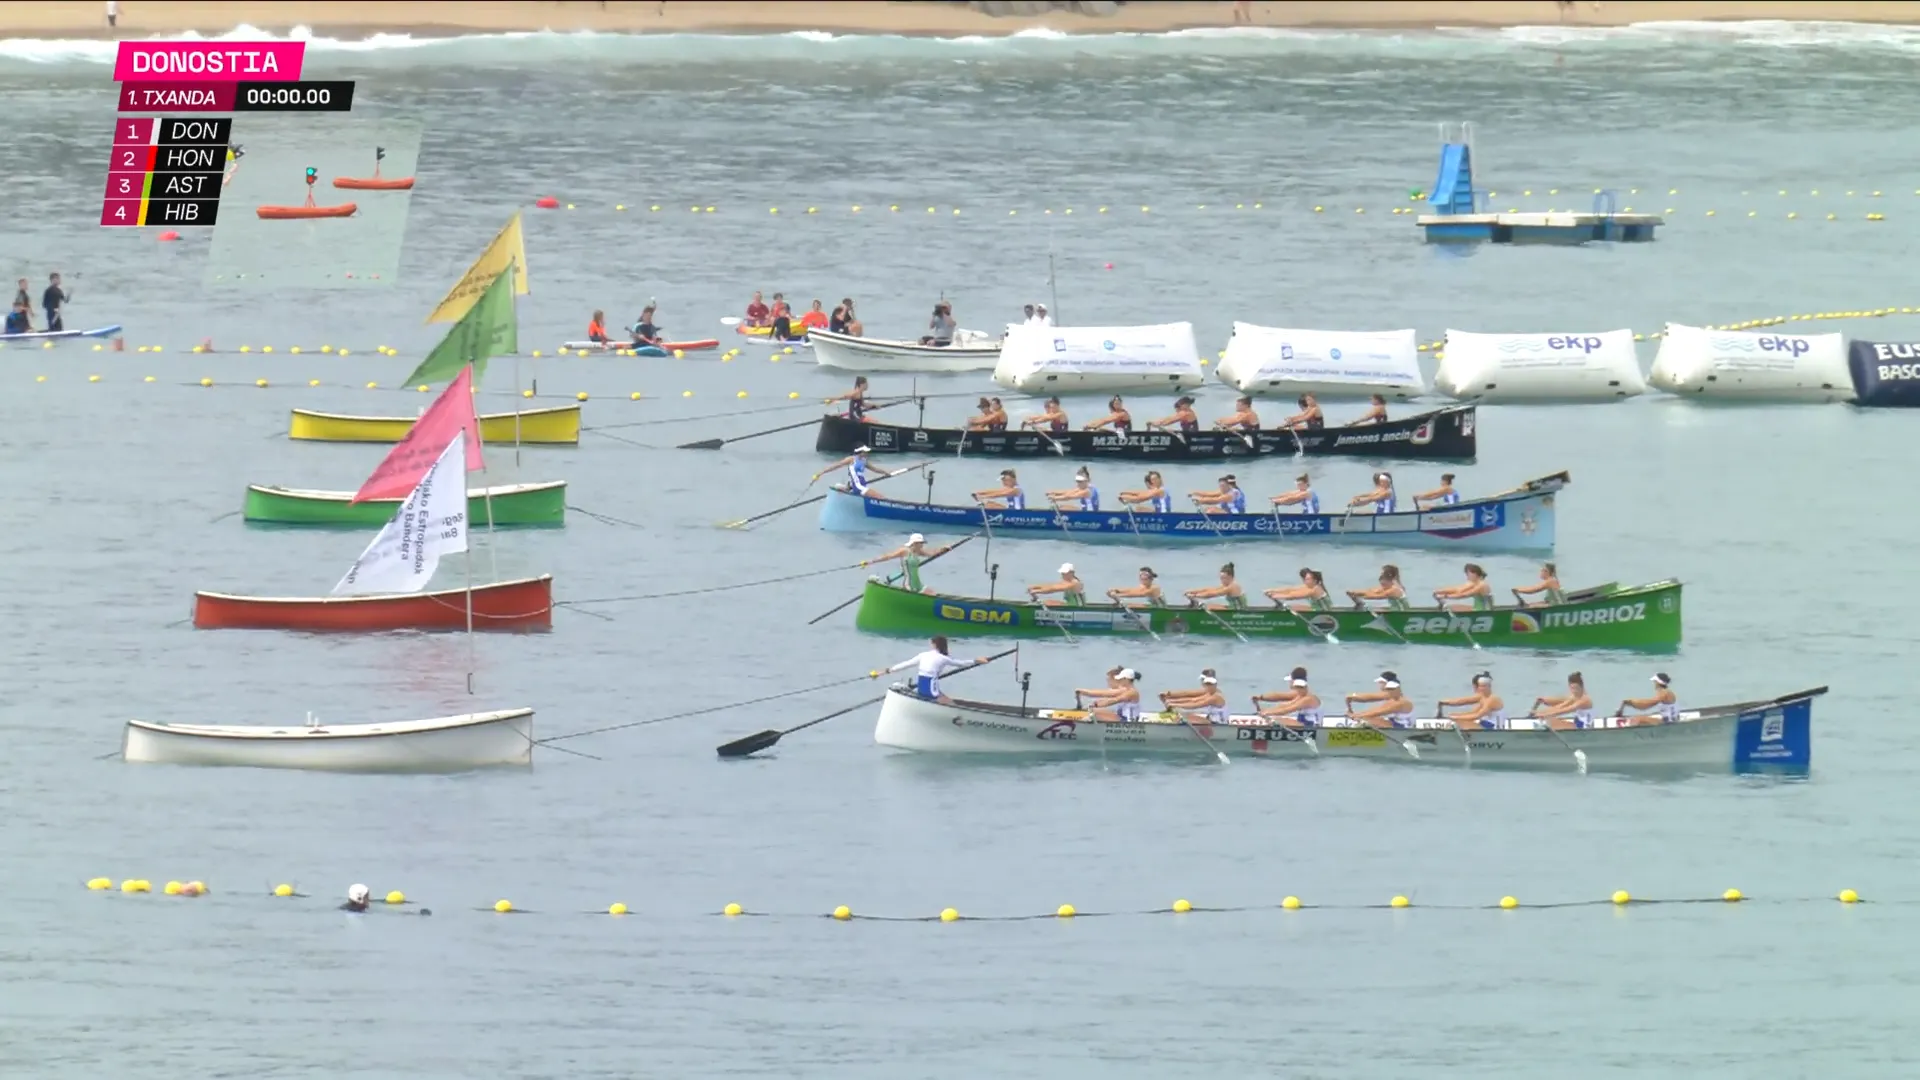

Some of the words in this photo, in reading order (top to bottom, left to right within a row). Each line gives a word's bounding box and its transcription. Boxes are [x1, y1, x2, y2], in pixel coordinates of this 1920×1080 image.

[1548, 333, 1602, 354] ekp
[1758, 335, 1810, 358] ekp
[1175, 520, 1248, 531] ASTANDER
[401, 512, 415, 561] Bandera
[969, 609, 1011, 624] BM
[1544, 602, 1646, 628] ITURRIOZ
[1403, 616, 1494, 634] aena
[1239, 729, 1315, 740] DRUCK
